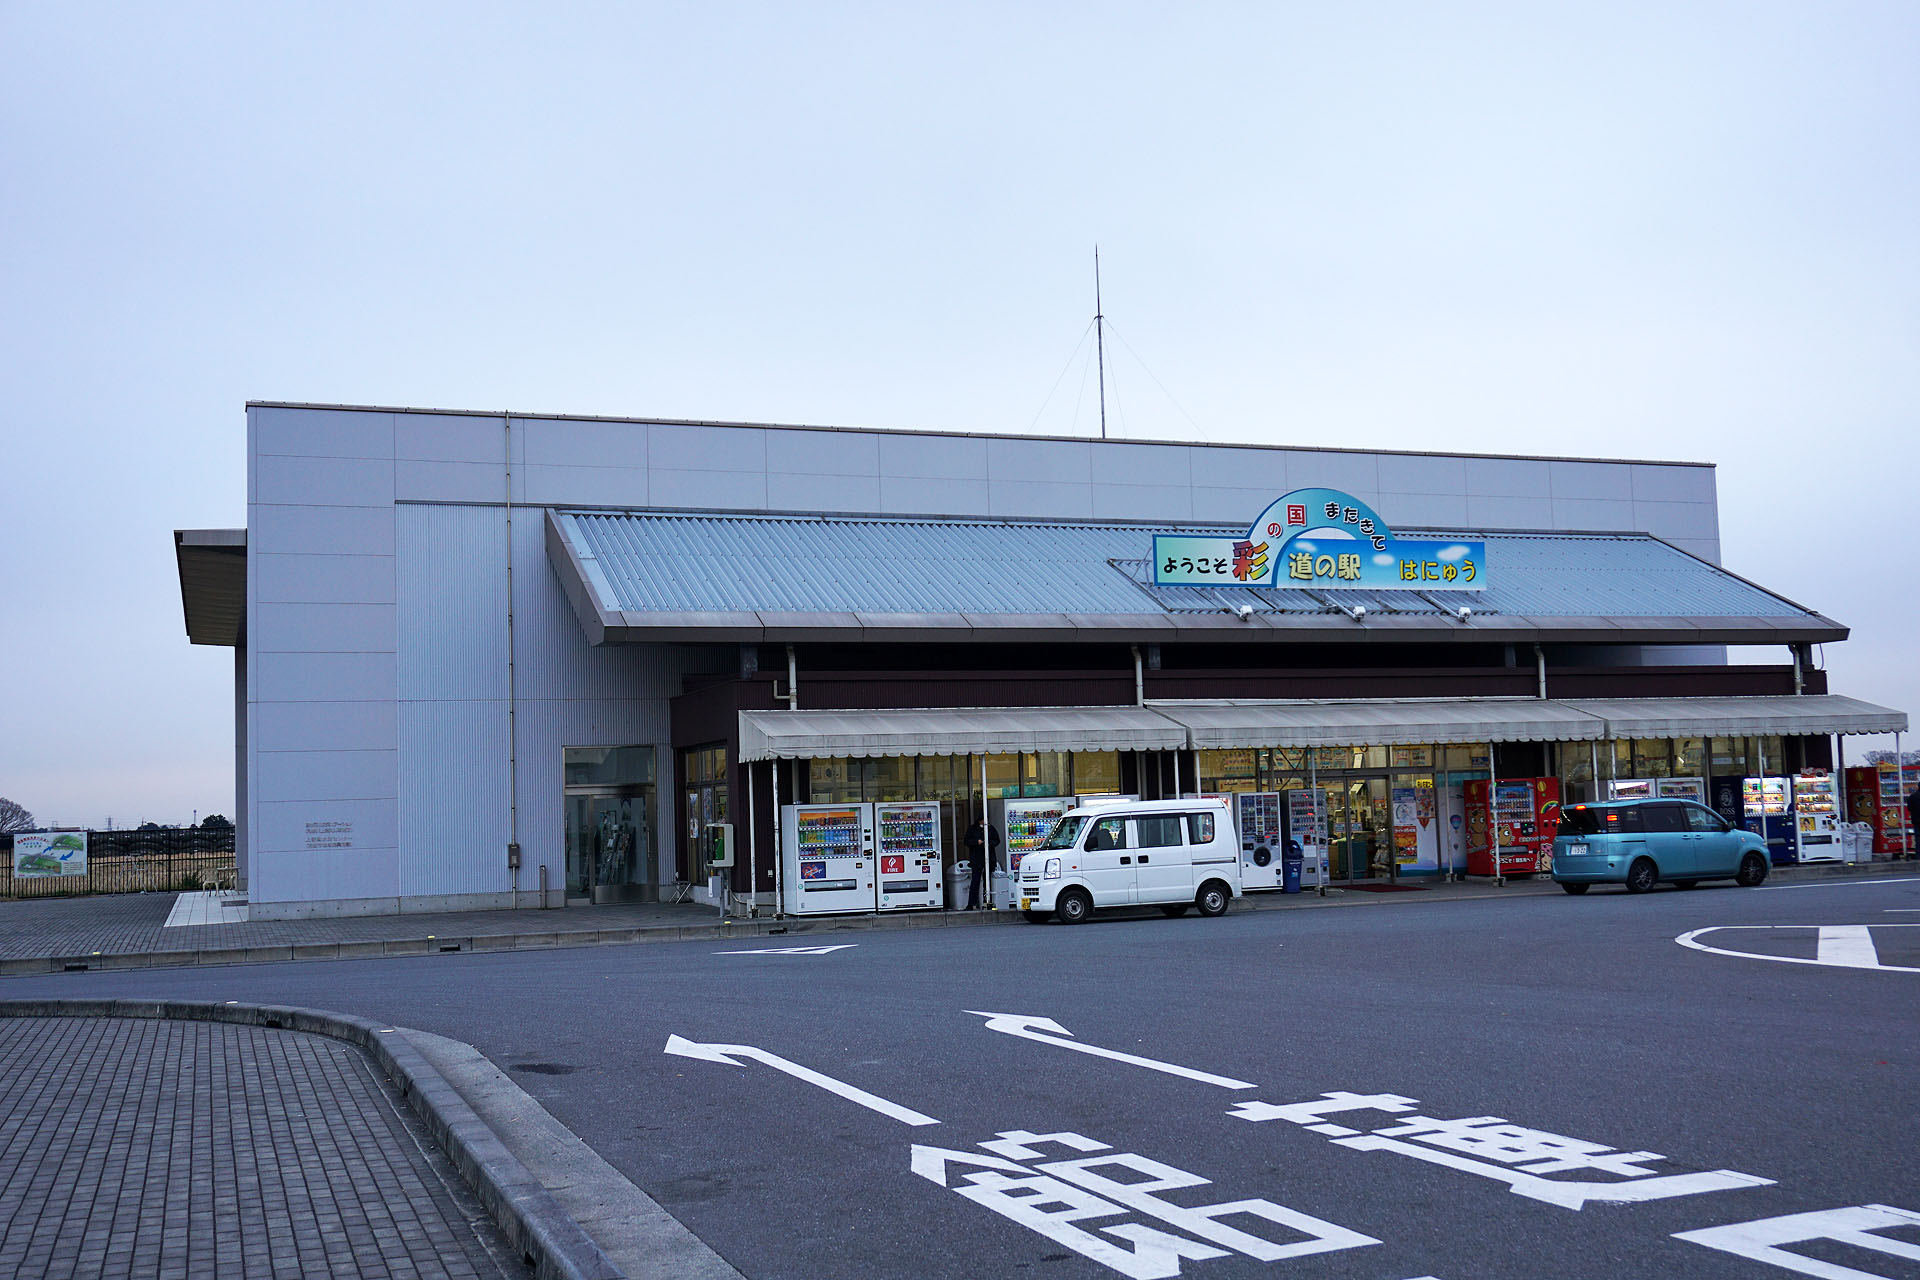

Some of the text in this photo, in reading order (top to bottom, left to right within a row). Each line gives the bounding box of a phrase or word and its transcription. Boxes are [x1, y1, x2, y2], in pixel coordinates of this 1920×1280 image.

[1324, 502, 1387, 552] またきて
[1163, 556, 1228, 575] ようこそ
[1288, 552, 1477, 582] 道の駅 はにゅう
[910, 1129, 1441, 1280] 館
